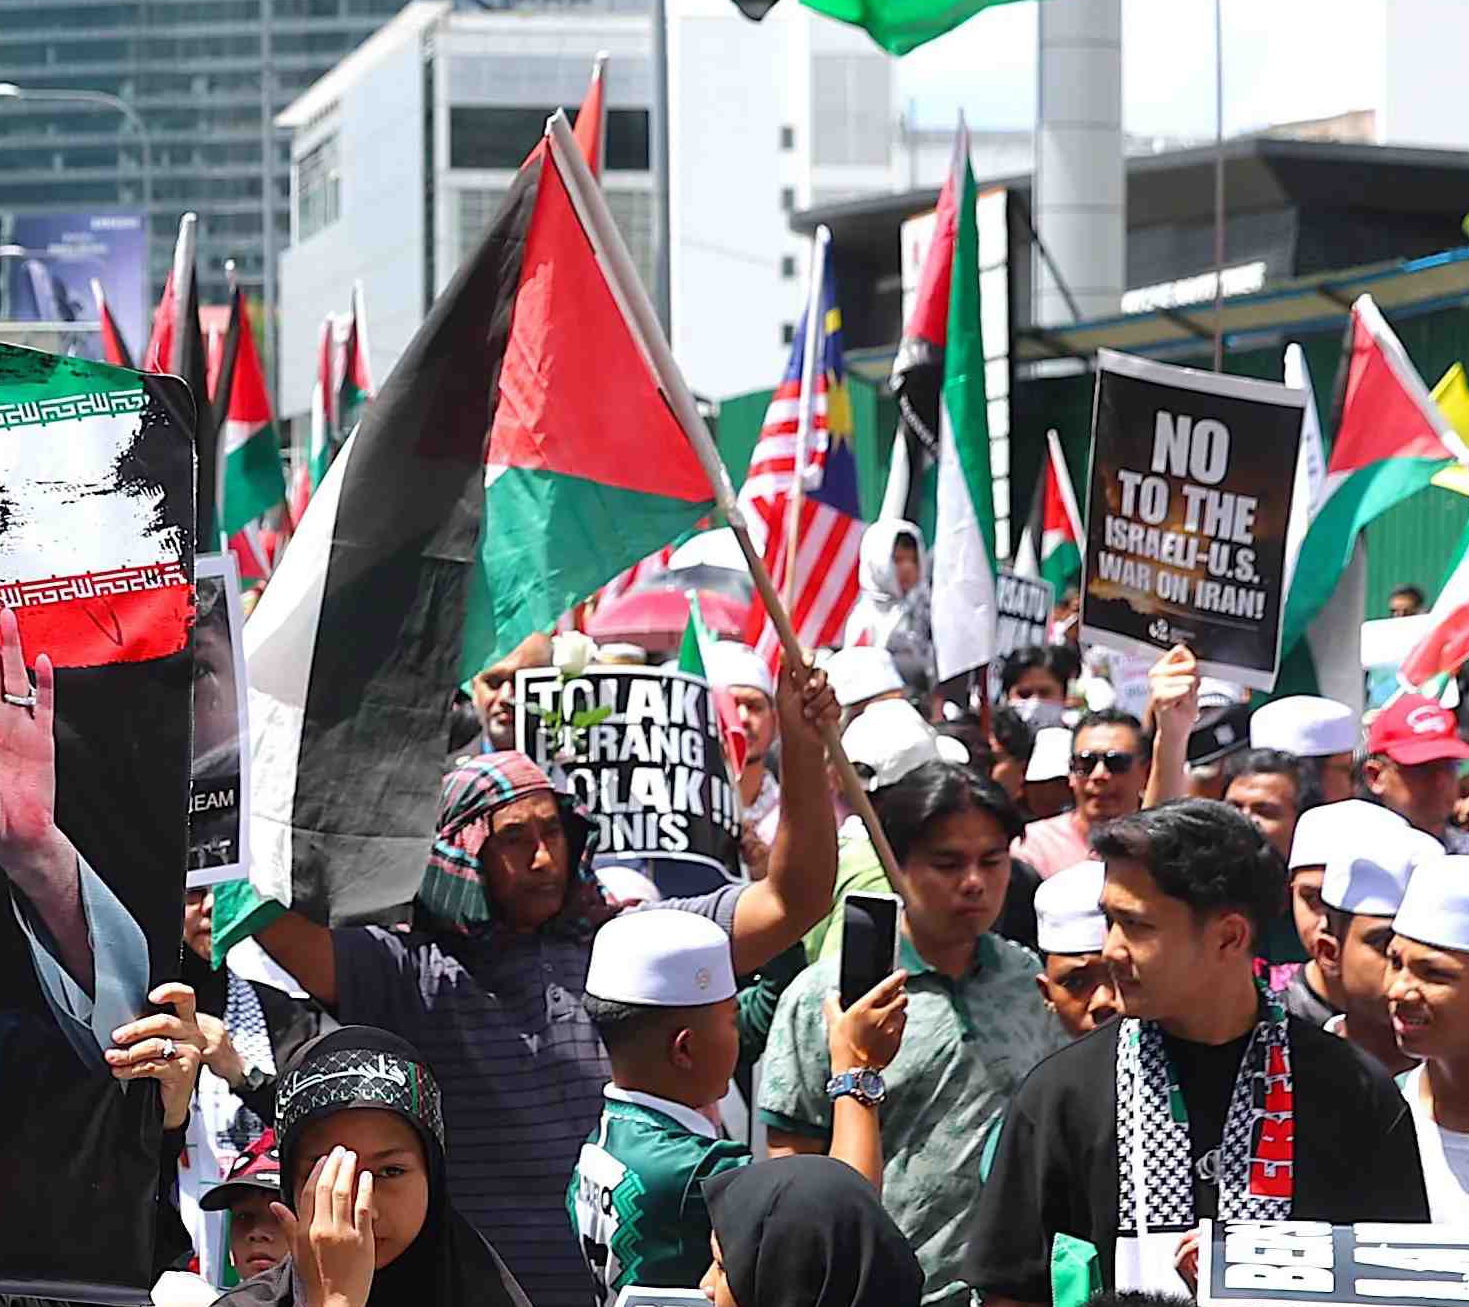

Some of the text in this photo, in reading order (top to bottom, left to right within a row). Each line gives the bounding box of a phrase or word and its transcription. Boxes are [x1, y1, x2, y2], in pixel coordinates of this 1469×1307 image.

[1152, 410, 1230, 485] NO
[1118, 469, 1258, 545] TO THE
[1105, 515, 1261, 584] ISRAELI-U.S.
[1098, 551, 1266, 620] WAR ON IRAN!
[194, 789, 235, 812] EAM
